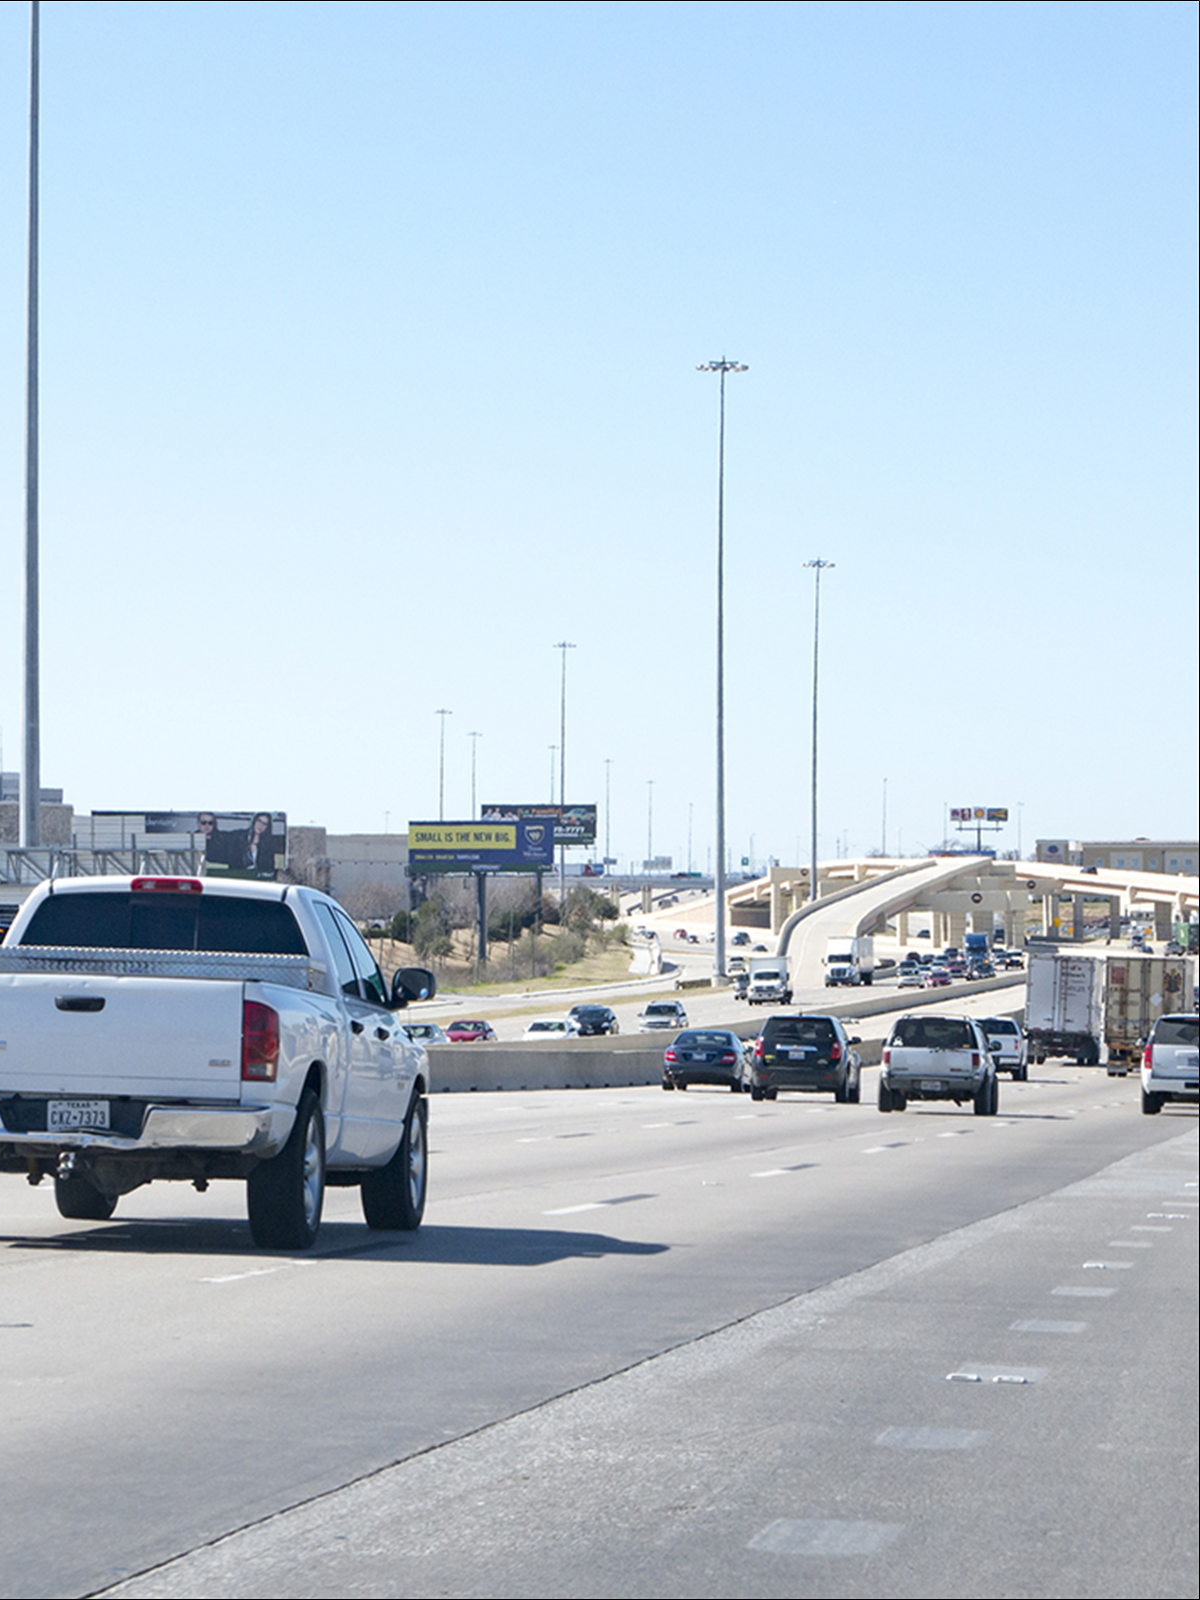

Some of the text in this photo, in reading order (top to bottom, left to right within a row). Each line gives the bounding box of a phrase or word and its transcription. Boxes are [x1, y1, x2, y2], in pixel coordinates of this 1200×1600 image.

[415, 832, 512, 842] SMALL IS THE NEW BIG.
